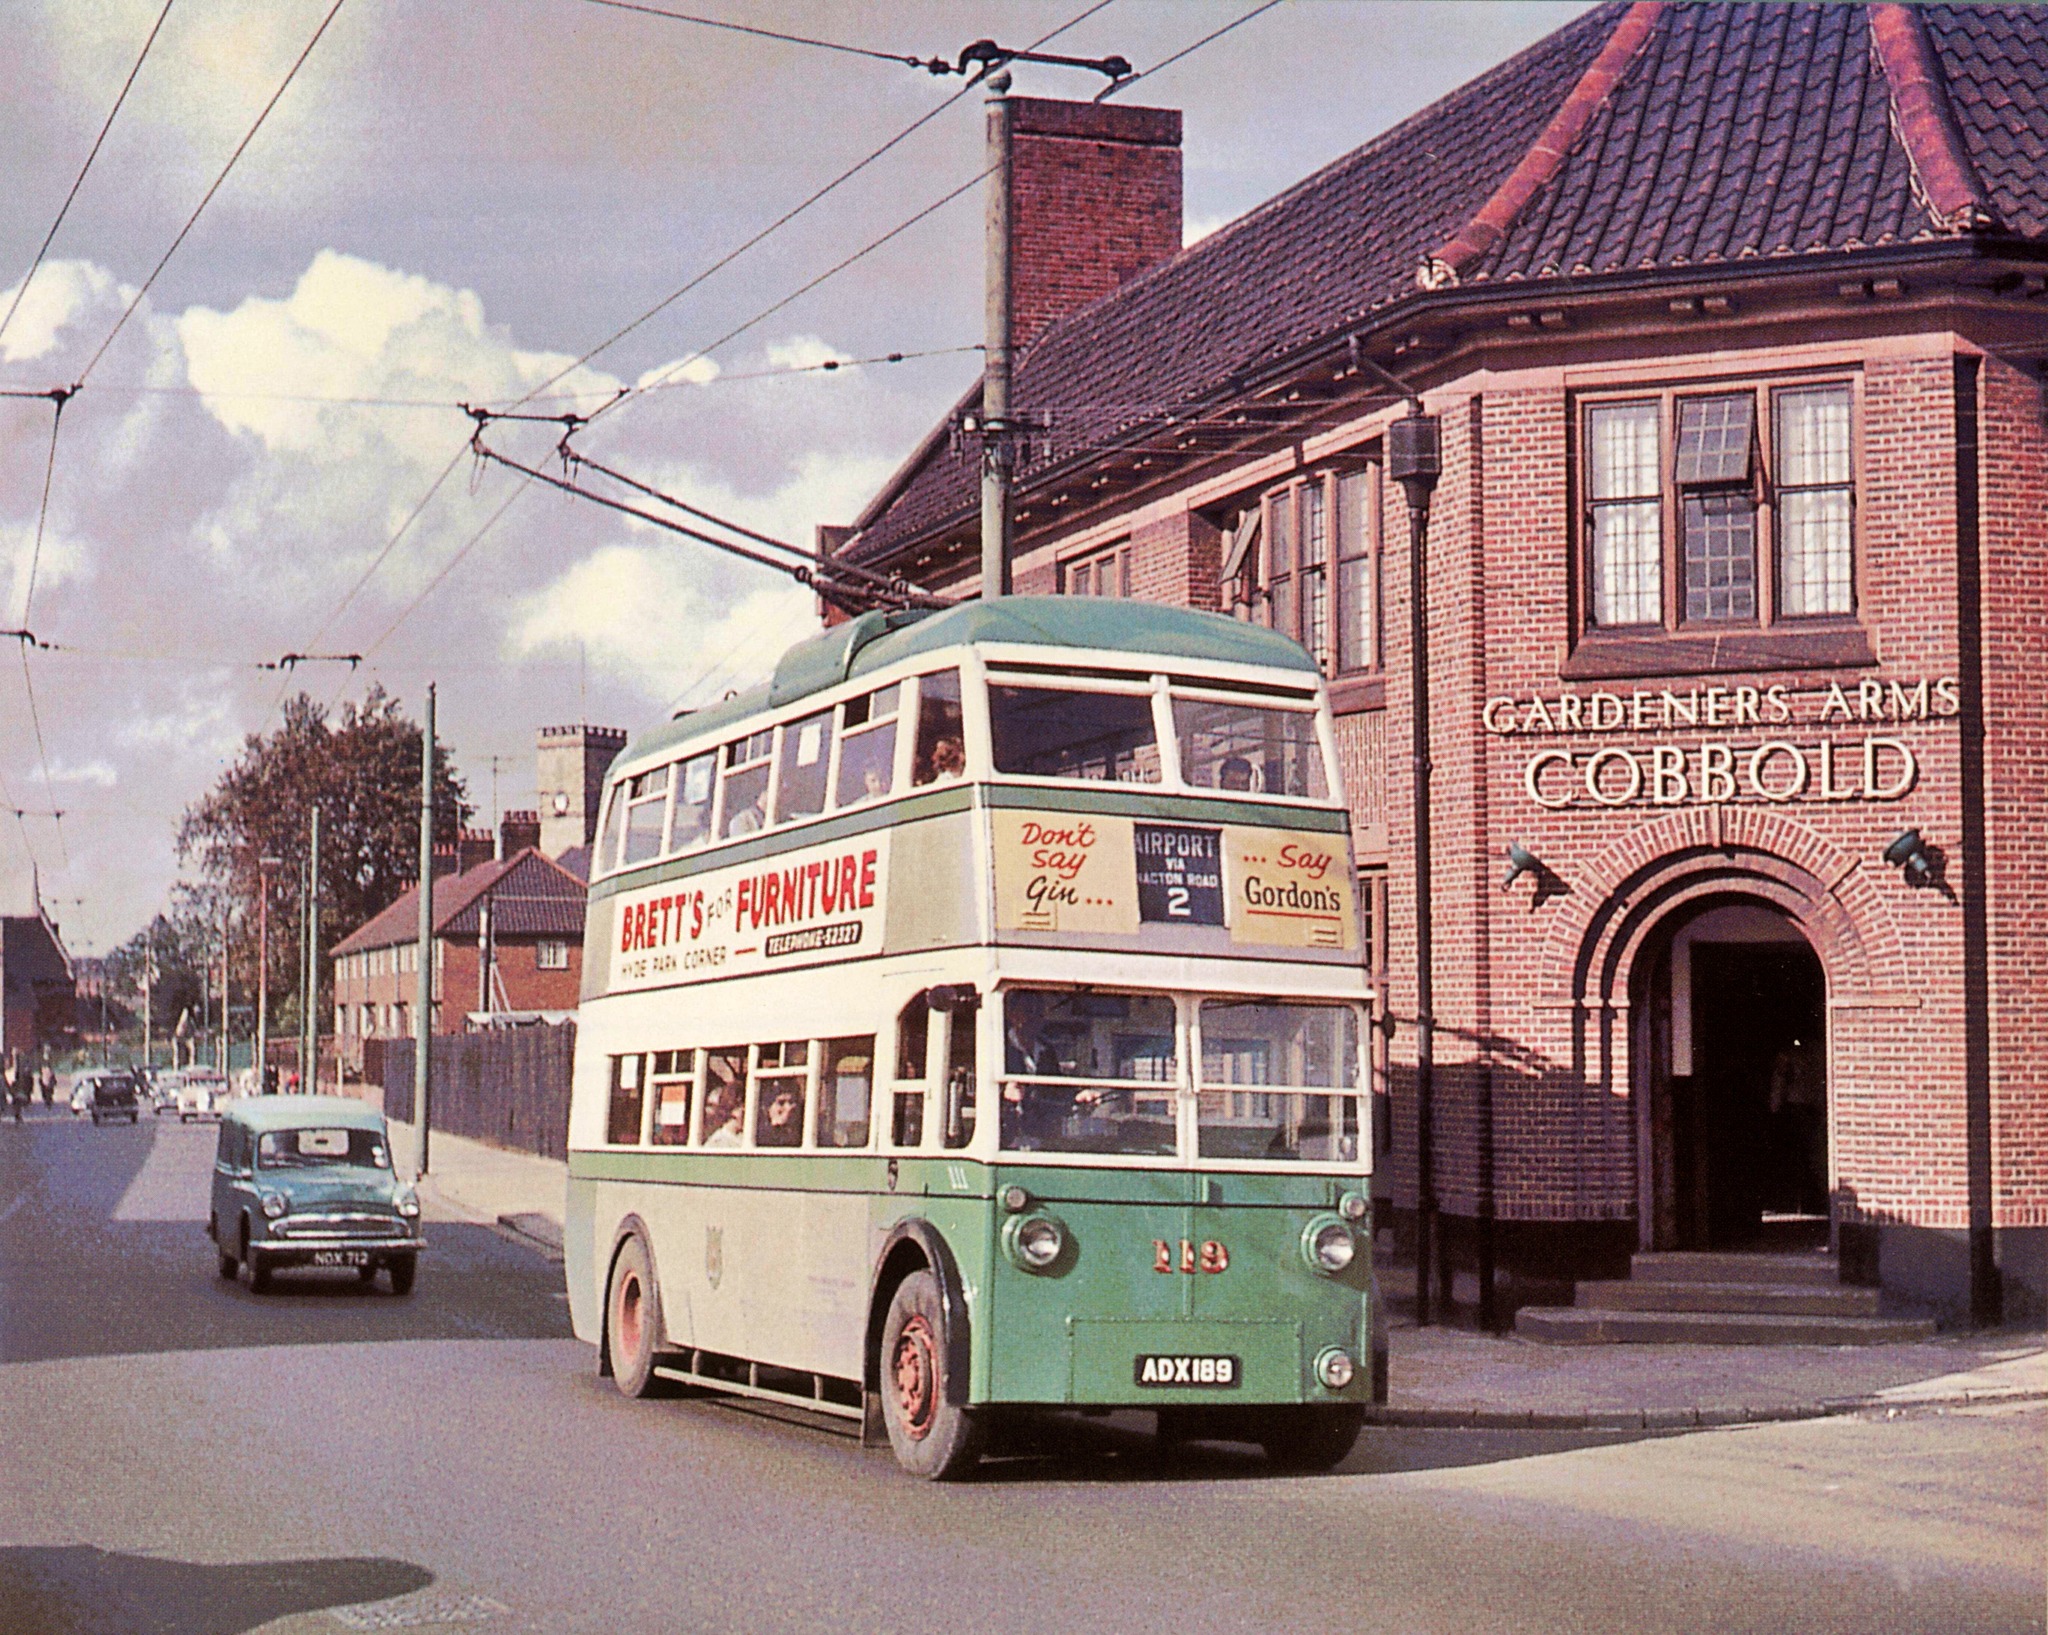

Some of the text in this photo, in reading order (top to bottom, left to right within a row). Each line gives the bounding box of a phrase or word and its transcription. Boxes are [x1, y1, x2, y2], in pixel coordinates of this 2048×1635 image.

[1482, 676, 1961, 733] GARDENERS ARMS
[1524, 737, 1919, 808] COBBOLD
[1021, 822, 1096, 847] Don't
[1165, 858, 1185, 871] VIA
[1277, 844, 1333, 879] Say
[1026, 874, 1079, 911] Gin
[1186, 873, 1219, 888] ROAD
[1245, 875, 1341, 911] Gordon's
[621, 849, 878, 953] BRETT'S FOR FURNITURE
[1167, 887, 1192, 916] 2
[621, 946, 727, 979] HYDE PARK CORNER
[1152, 1239, 1230, 1275] 119
